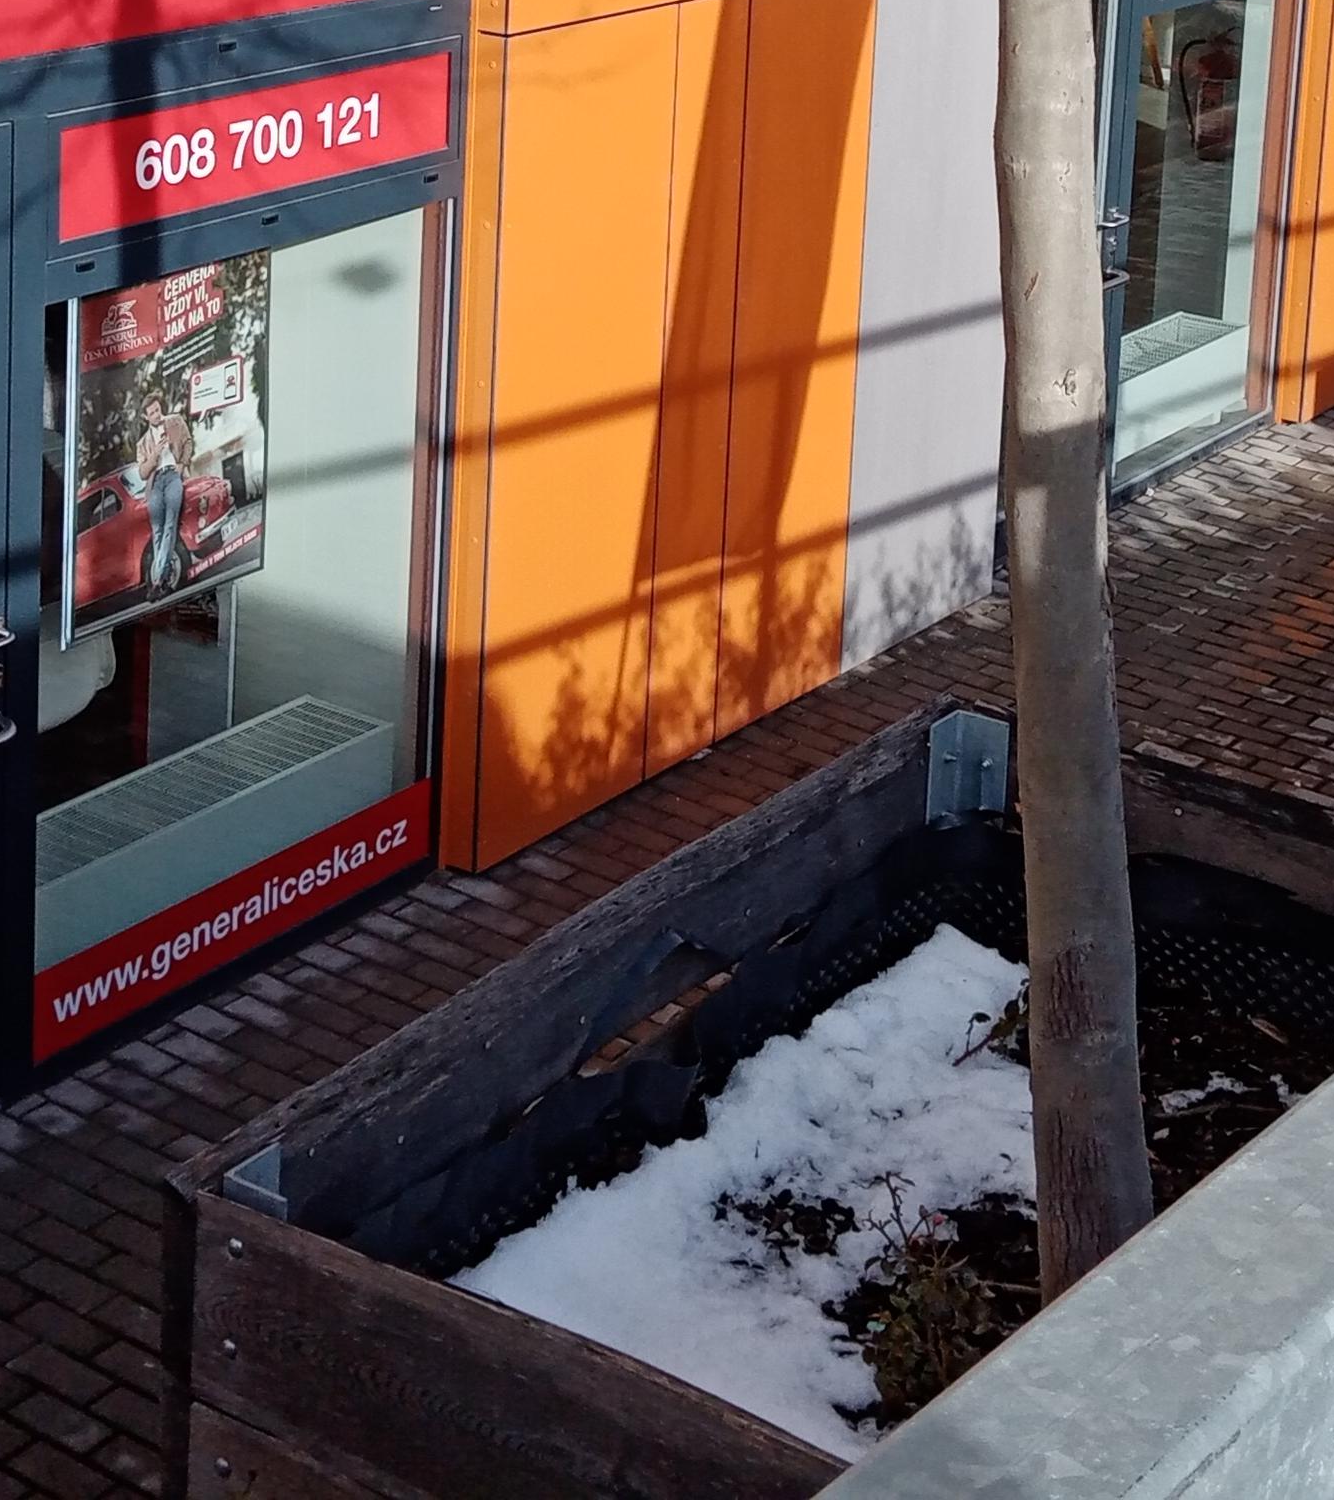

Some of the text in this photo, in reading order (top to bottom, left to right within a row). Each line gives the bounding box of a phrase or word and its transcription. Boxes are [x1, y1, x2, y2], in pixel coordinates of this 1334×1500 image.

[135, 92, 380, 191] 608 700 121
[163, 297, 220, 343] JAK NA TO
[164, 291, 193, 322] VŽDY
[52, 818, 409, 1024] www.generaliceska.cz
